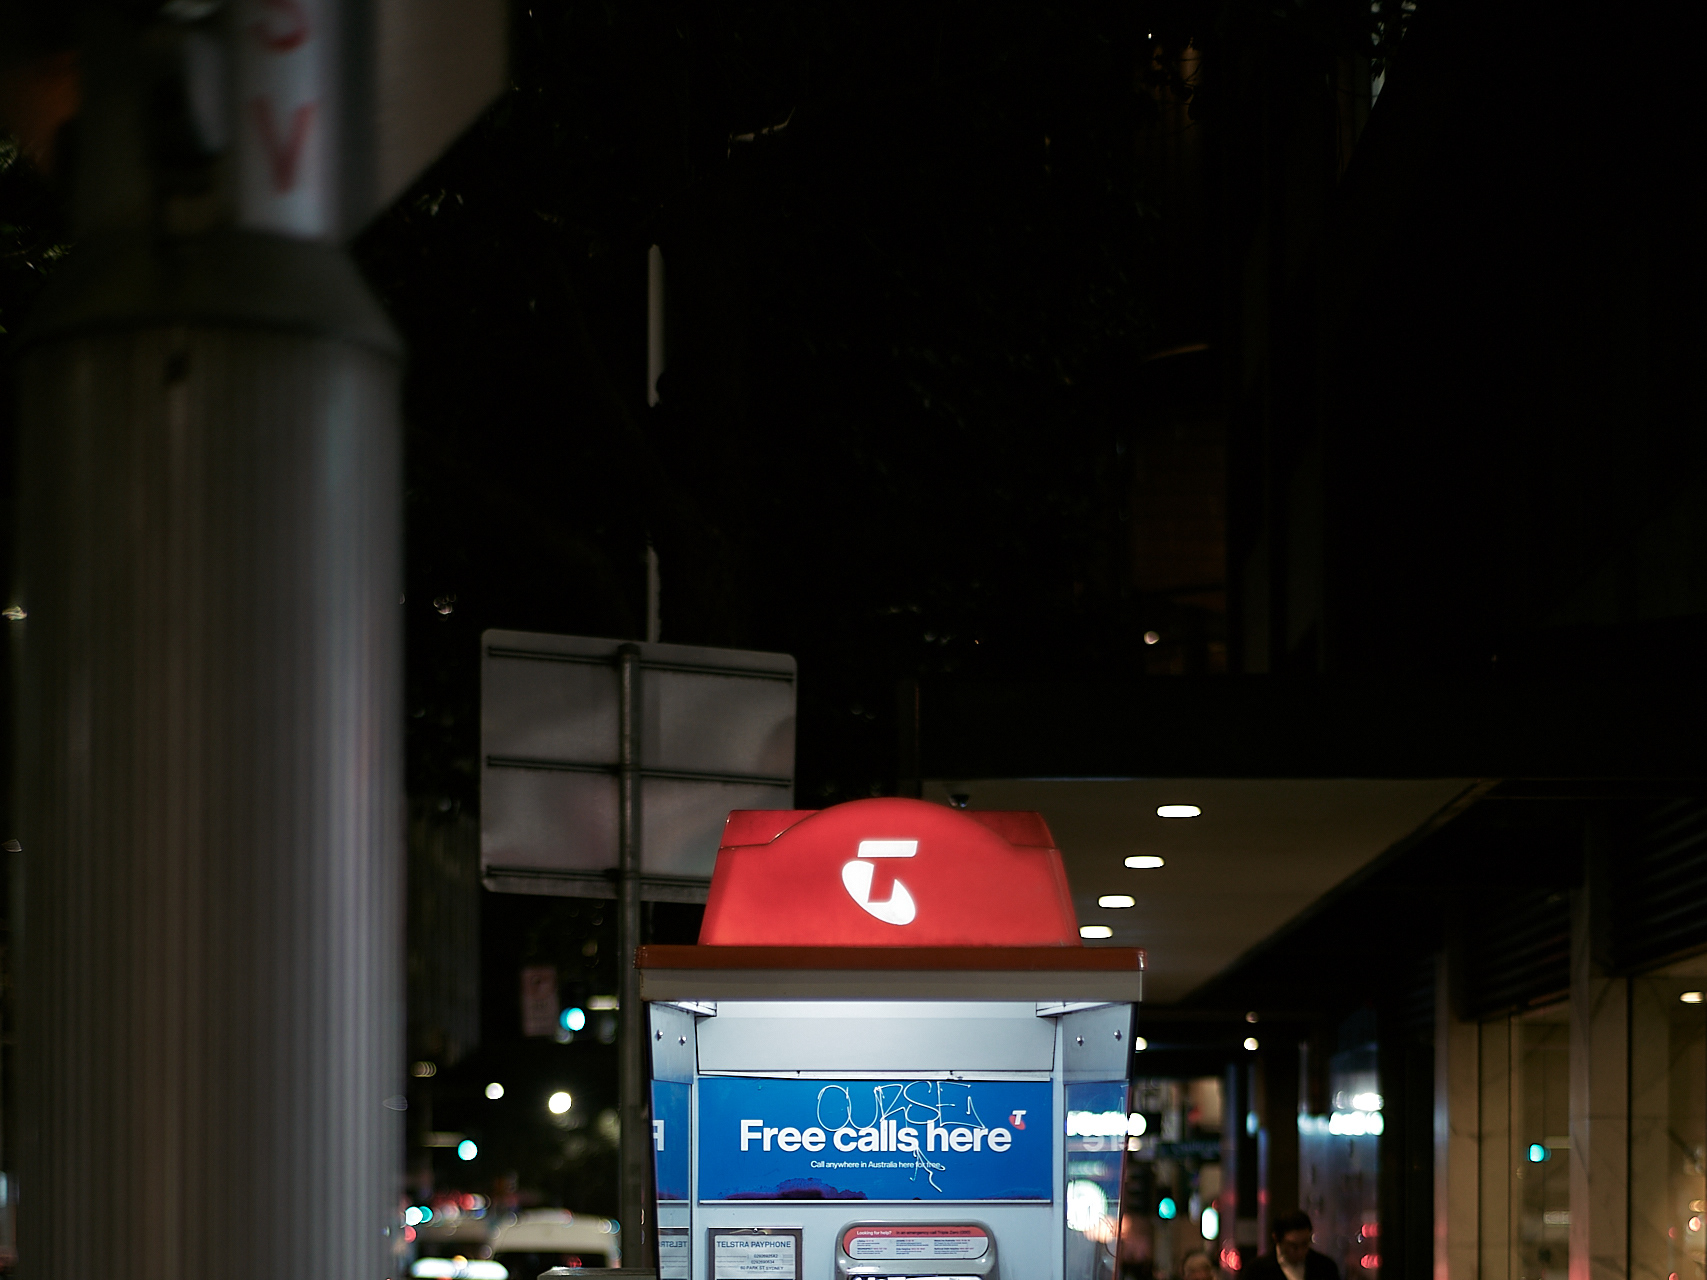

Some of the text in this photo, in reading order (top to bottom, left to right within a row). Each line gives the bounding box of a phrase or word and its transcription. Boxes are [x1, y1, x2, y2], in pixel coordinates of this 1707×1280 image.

[740, 1119, 1012, 1153] Free calls here
[810, 1160, 825, 1169] Call
[825, 1160, 860, 1170] anywhere
[860, 1160, 868, 1169] in
[868, 1160, 898, 1169] Australia
[898, 1160, 915, 1169] here
[716, 1240, 791, 1248] TELSTRA PAYPHONE
